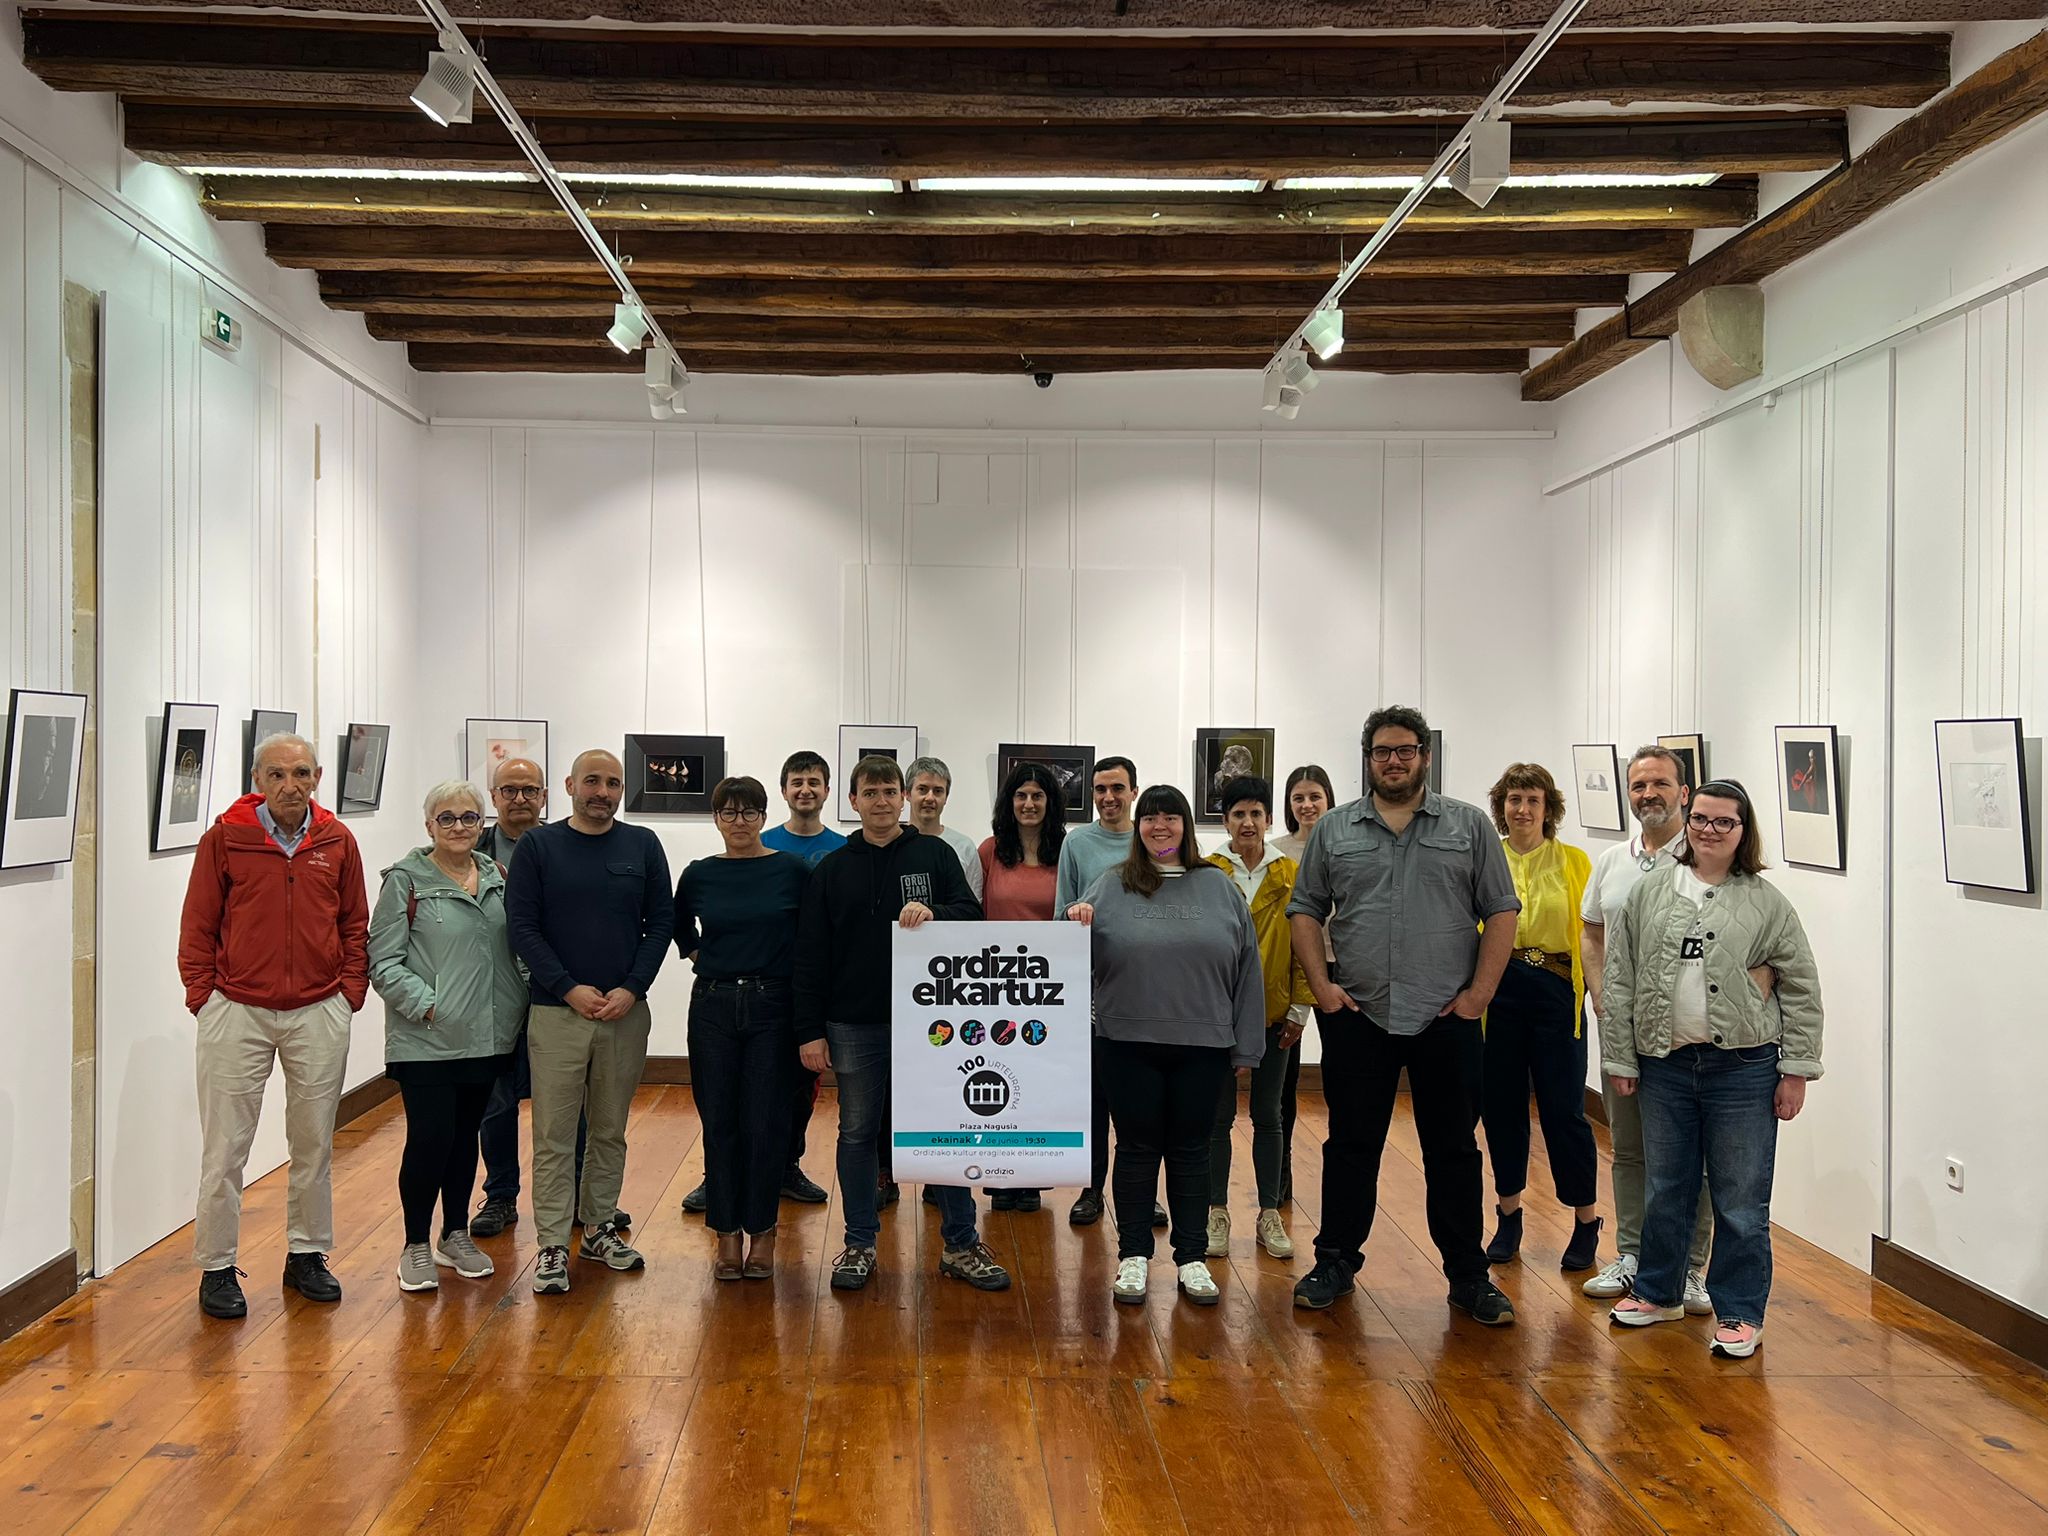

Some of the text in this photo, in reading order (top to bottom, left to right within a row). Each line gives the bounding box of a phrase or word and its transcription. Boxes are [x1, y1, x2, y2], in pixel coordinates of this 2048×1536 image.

[904, 876, 927, 887] ORDI
[905, 885, 929, 898] ZIAR
[928, 945, 1049, 979] ordizia
[912, 976, 1065, 1006] elkartuz
[957, 1055, 1021, 1110] 100 URTEURRENA
[984, 1123, 1018, 1132] Nagusia
[931, 1136, 971, 1144] ekainak
[974, 1134, 983, 1144] 7
[998, 1137, 1019, 1146] junio
